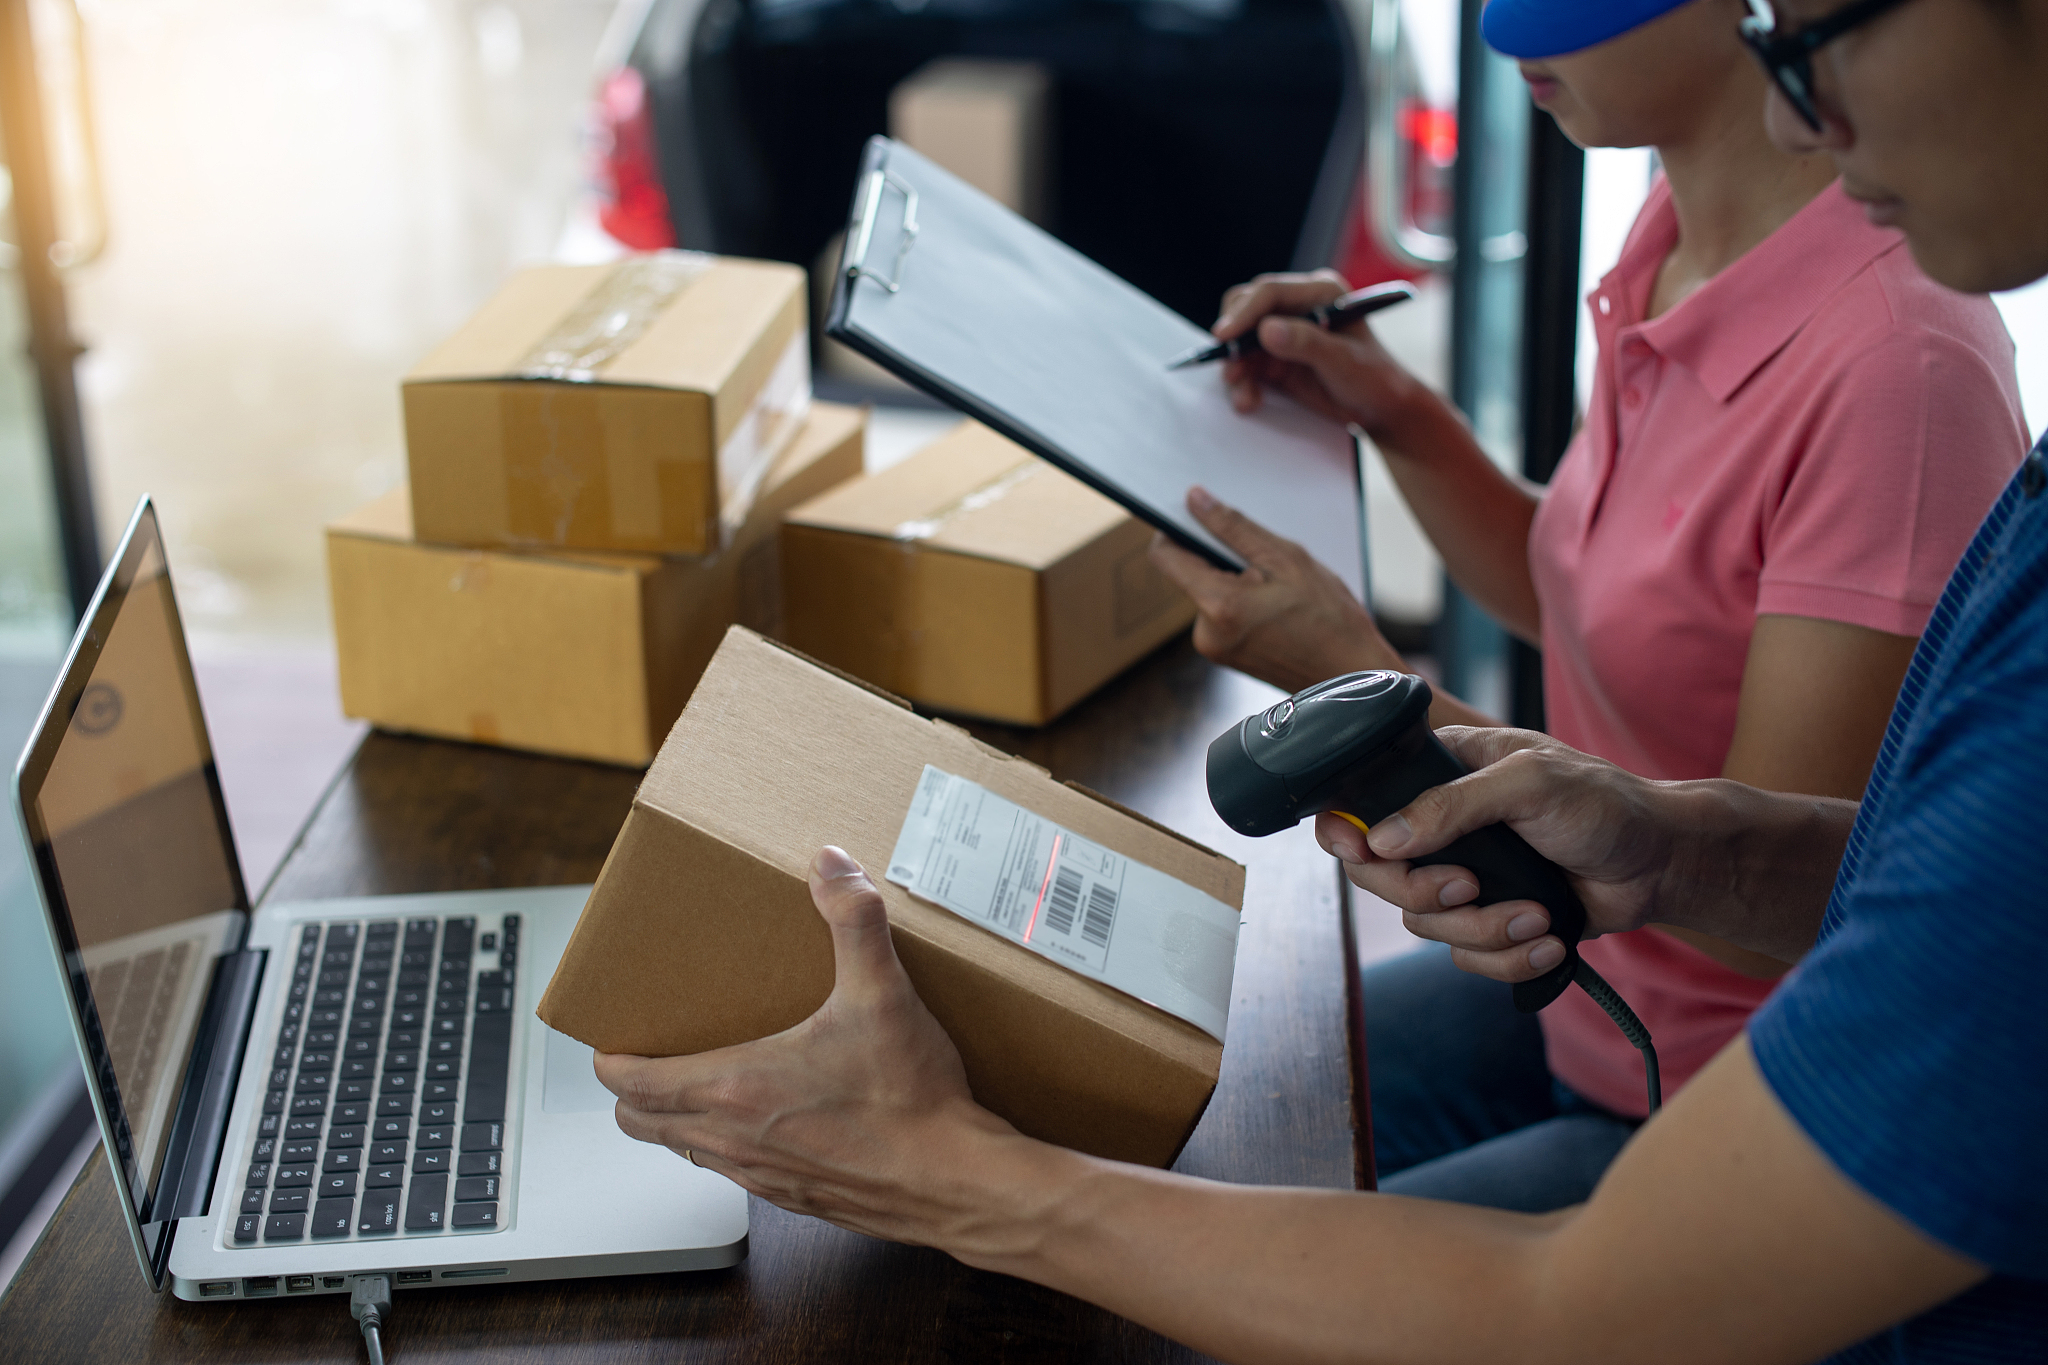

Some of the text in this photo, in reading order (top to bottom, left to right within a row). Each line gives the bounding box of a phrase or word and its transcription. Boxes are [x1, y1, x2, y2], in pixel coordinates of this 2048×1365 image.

[347, 1085, 360, 1093] T
[433, 1085, 446, 1094] V
[308, 1098, 322, 1106] 5
[344, 1108, 356, 1116] R
[431, 1108, 444, 1117] C
[385, 1123, 399, 1131] D
[429, 1132, 441, 1140] X
[335, 1154, 349, 1164] W
[425, 1156, 439, 1164] Z
[487, 1155, 497, 1171] option
[331, 1179, 345, 1187] Q
[486, 1179, 495, 1196] control
[384, 1203, 394, 1213] lock
[384, 1214, 394, 1226] caps
[429, 1211, 439, 1223] shift
[243, 1220, 252, 1231] esc
[336, 1219, 346, 1228] tab
